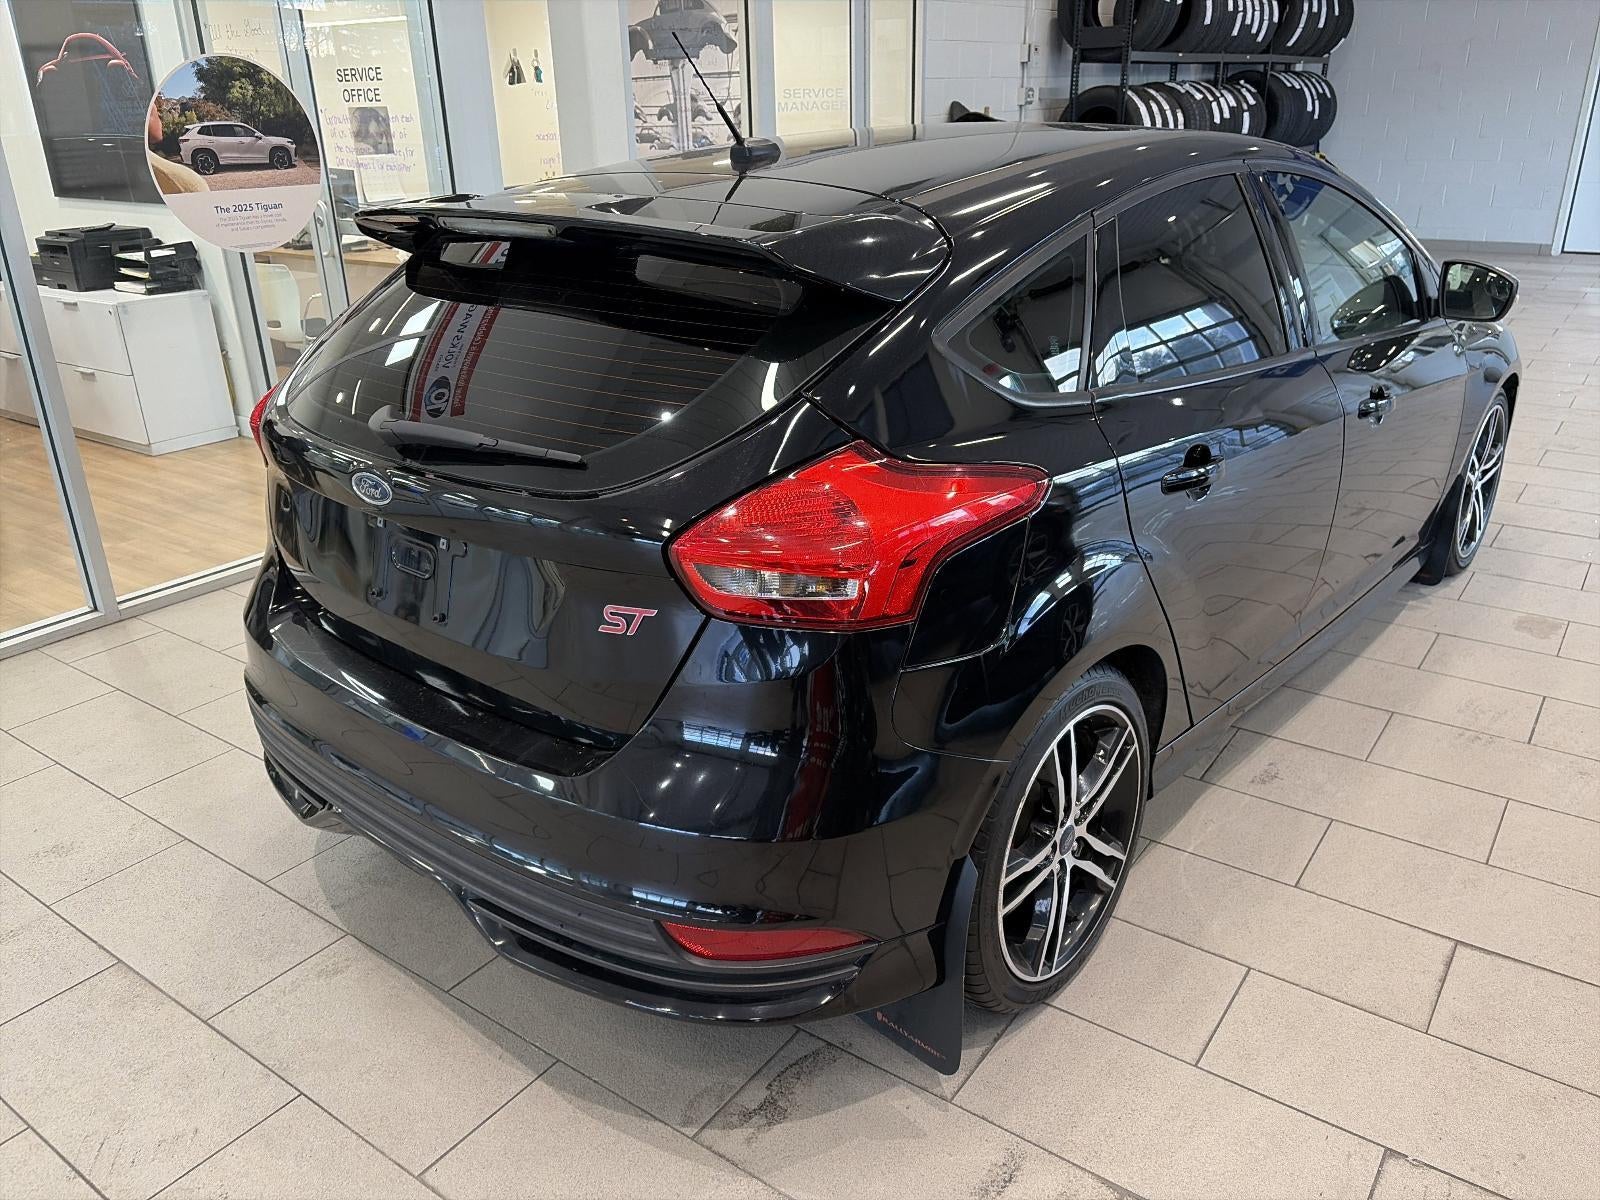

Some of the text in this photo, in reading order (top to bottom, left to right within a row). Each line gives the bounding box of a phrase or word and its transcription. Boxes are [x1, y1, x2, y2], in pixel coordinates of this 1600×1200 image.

[336, 65, 384, 84] SERVICE
[342, 88, 382, 103] OFFICE
[783, 88, 844, 99] SERVICE
[777, 100, 848, 113] MANAGER
[214, 202, 284, 214] The 2025 Tiguan
[359, 477, 384, 499] Ford
[597, 604, 658, 636] ST
